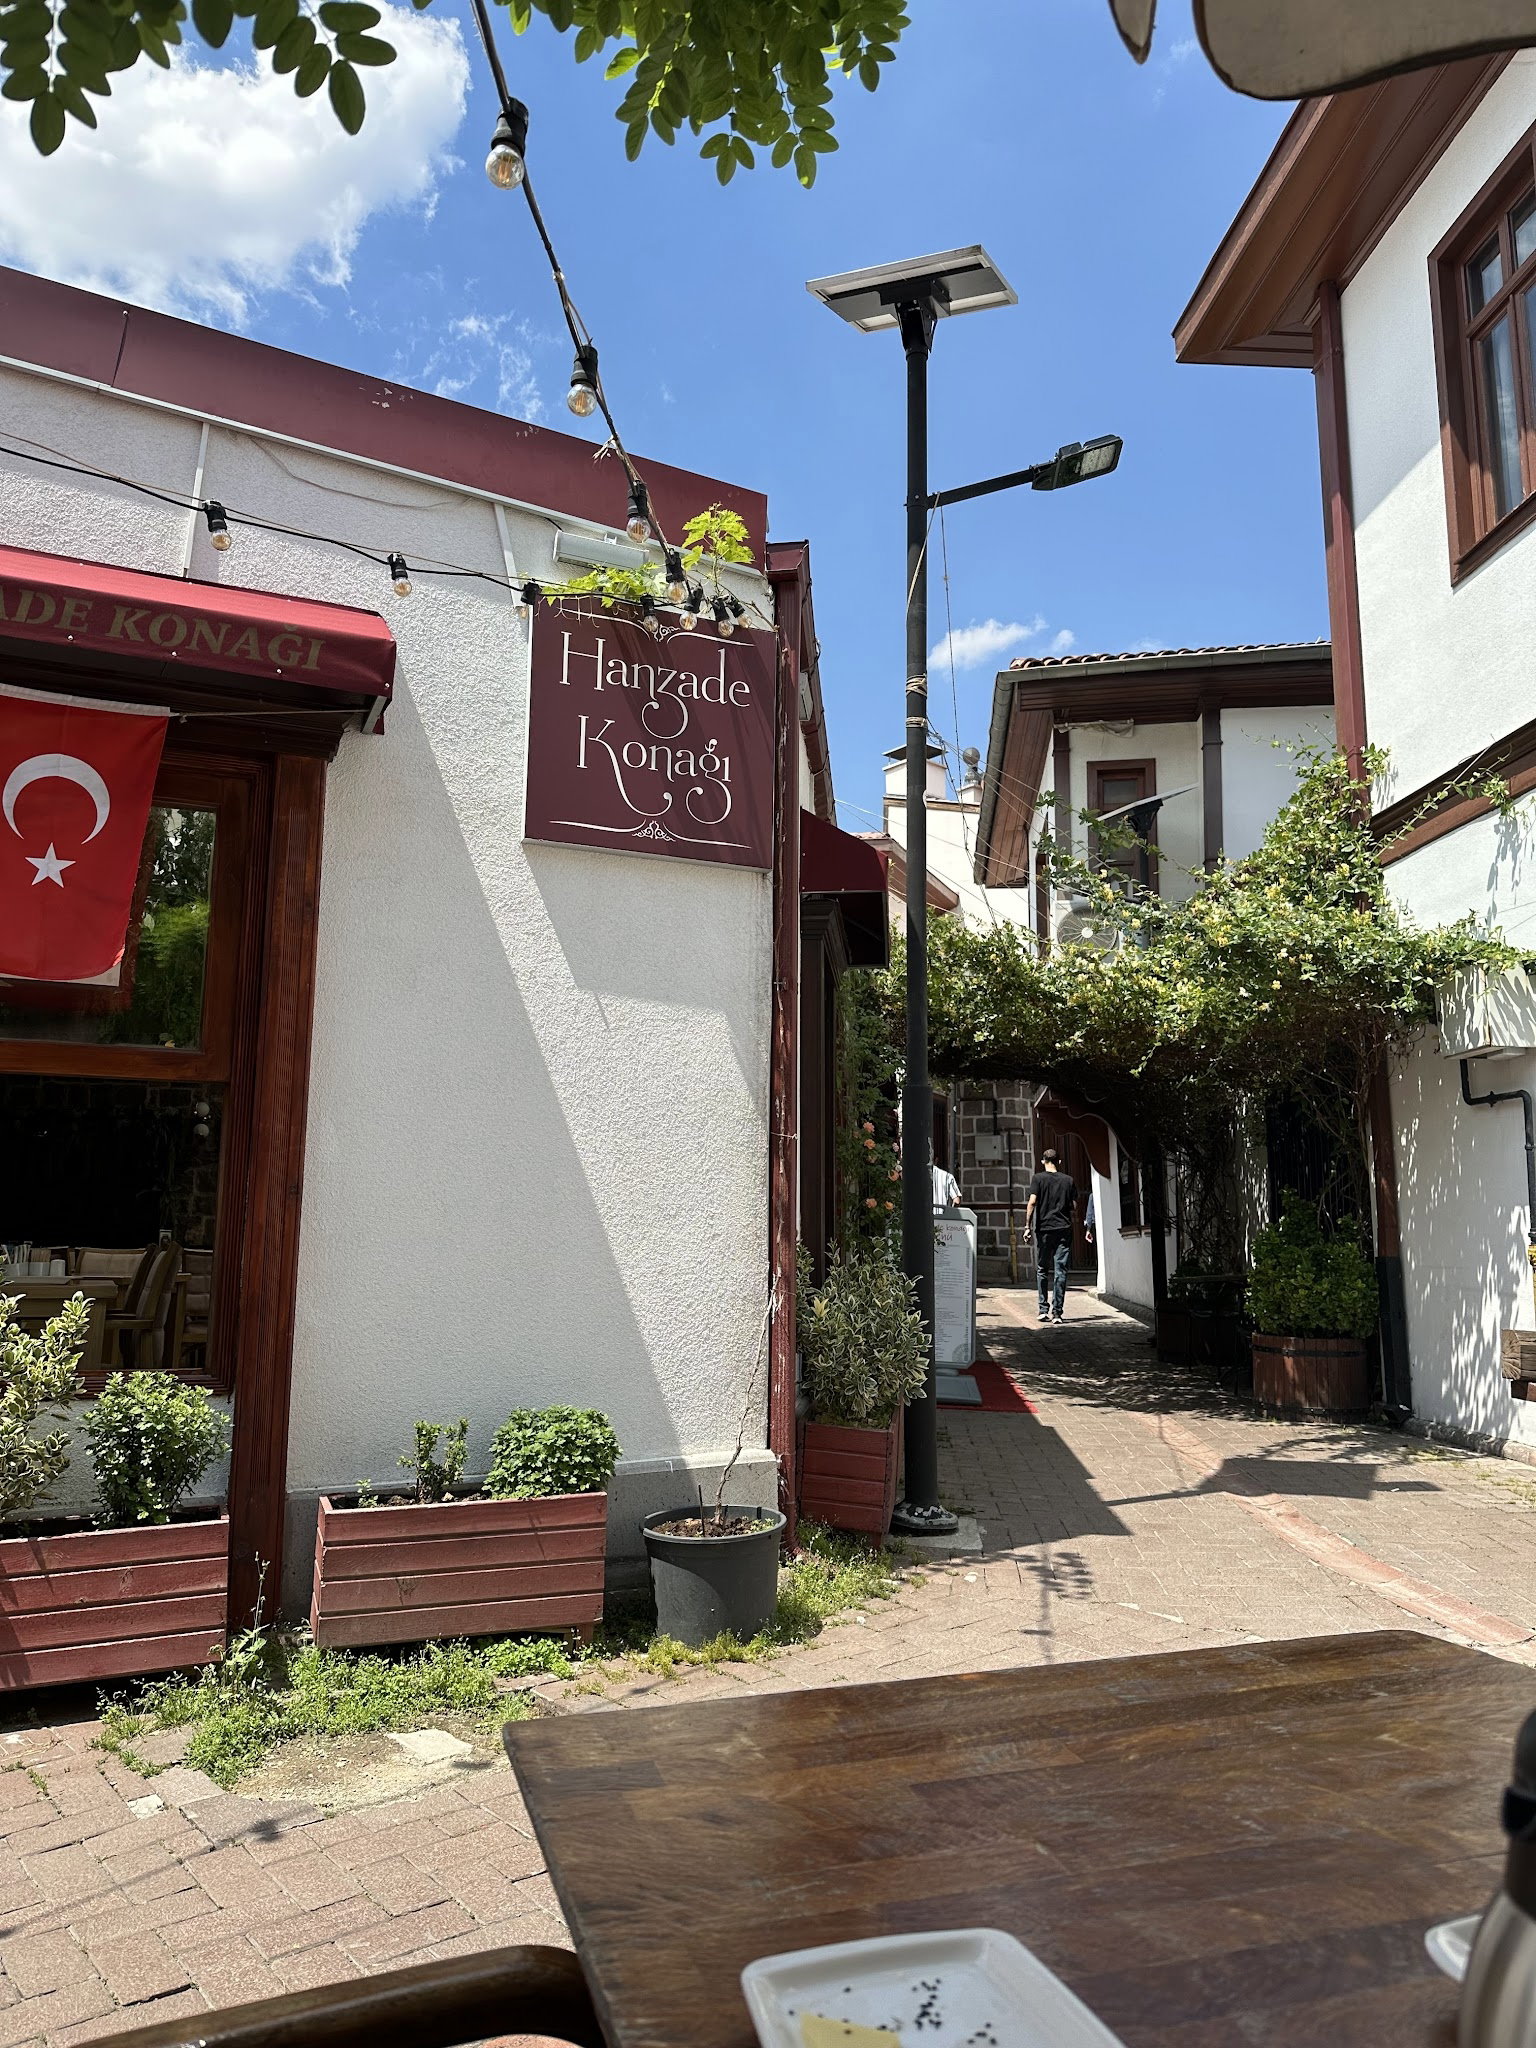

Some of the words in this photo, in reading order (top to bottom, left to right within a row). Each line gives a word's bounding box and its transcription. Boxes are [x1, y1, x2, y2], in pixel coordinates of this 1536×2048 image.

[0, 584, 94, 633] DE
[105, 606, 326, 670] KONAĞI
[560, 631, 750, 739] Hanzade
